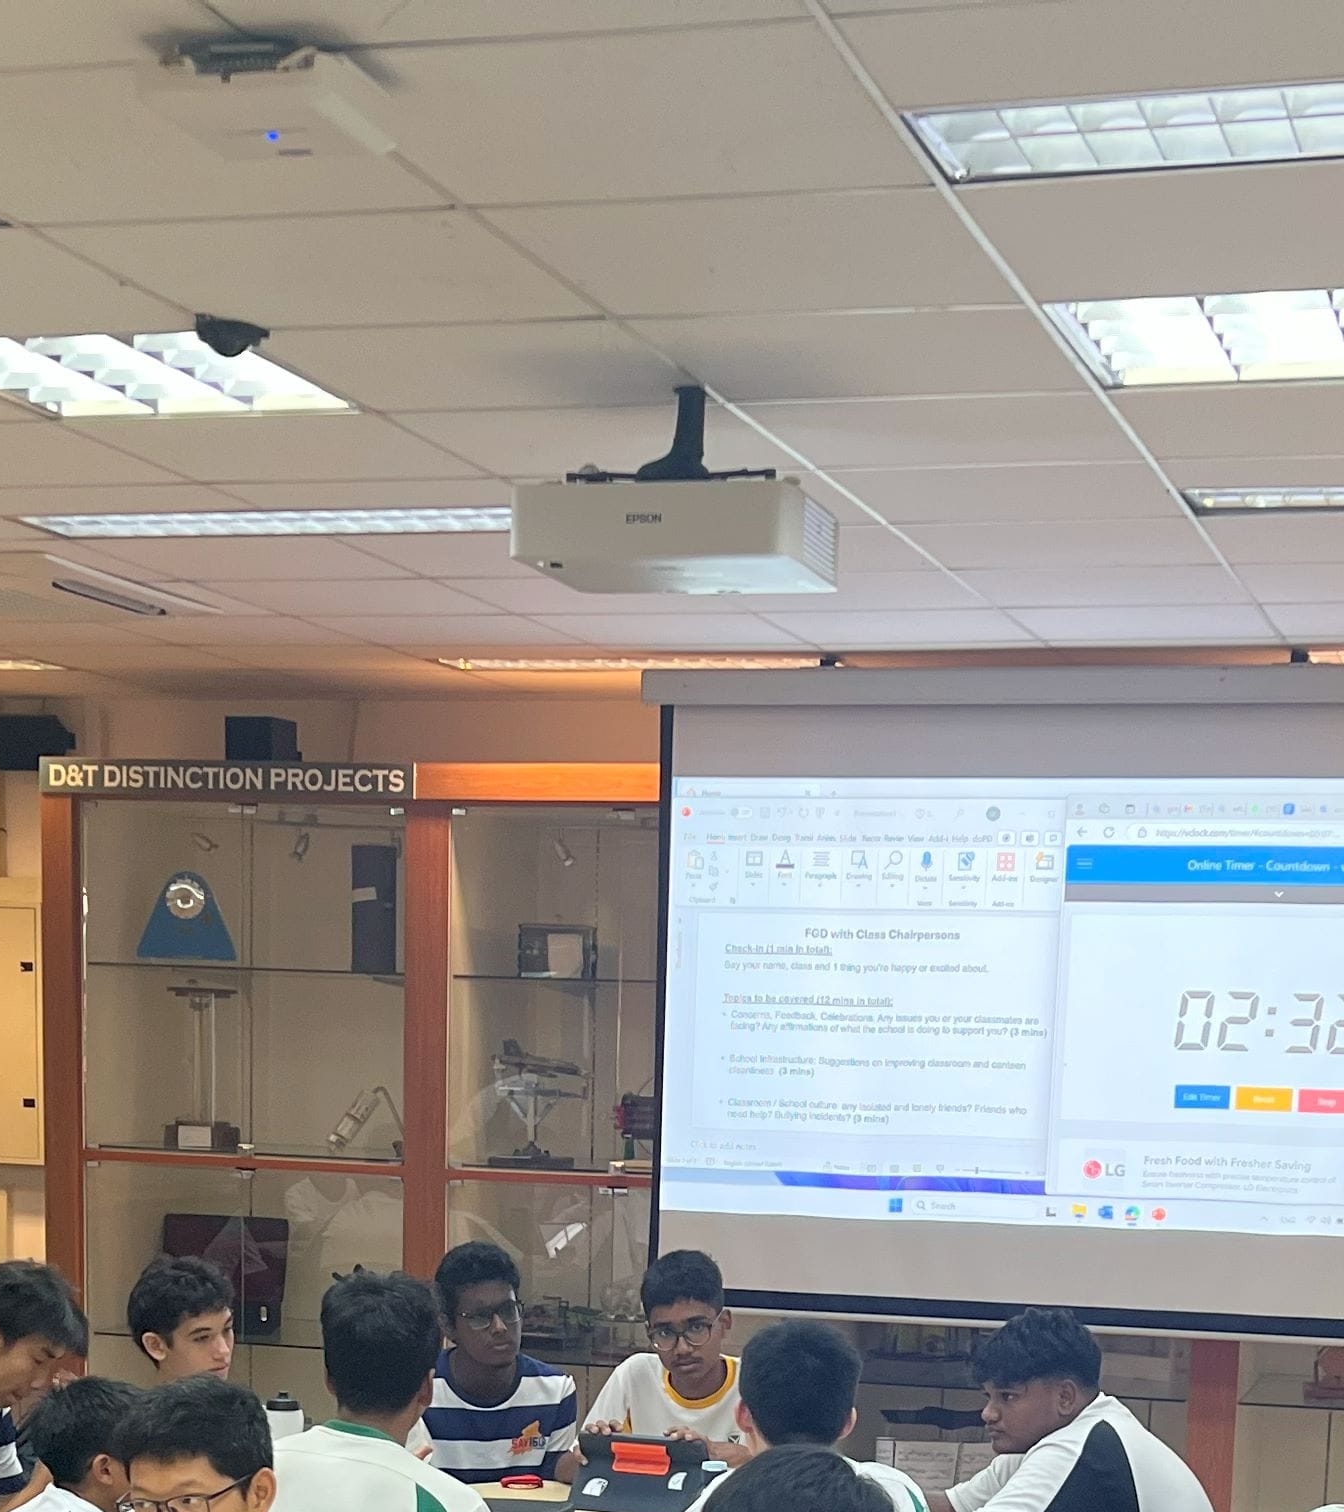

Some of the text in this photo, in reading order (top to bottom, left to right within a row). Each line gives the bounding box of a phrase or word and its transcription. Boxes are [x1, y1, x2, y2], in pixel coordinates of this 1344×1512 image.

[625, 512, 662, 525] EPSON
[48, 763, 406, 792] D&T DISTINCTION PROJECTS
[1187, 859, 1222, 871] Online
[1225, 859, 1255, 871] Timer
[1266, 860, 1331, 872] Countdown
[805, 928, 960, 942] FGD with Class Chairpersons
[742, 962, 760, 971] your
[763, 962, 788, 971] name,
[791, 962, 812, 970] class
[814, 962, 830, 971] and
[840, 963, 861, 973] thing
[863, 963, 889, 973] you're
[891, 963, 917, 974] happy
[930, 964, 960, 972] excited
[754, 994, 763, 1003] to
[766, 995, 777, 1003] be
[779, 996, 814, 1005] covered
[832, 996, 854, 1006] mins
[857, 996, 865, 1006] in
[731, 1011, 772, 1020] Concerns,
[877, 1013, 893, 1023] Any
[896, 1014, 922, 1022] issues
[924, 1015, 940, 1024] you
[953, 1015, 972, 1024] your
[974, 1015, 1022, 1025] classmates
[1025, 1017, 1039, 1025] are
[730, 1022, 760, 1032] facing?
[762, 1022, 777, 1033] Any
[780, 1023, 828, 1033] affirmations
[830, 1023, 839, 1033] of
[840, 1024, 860, 1033] what
[863, 1024, 876, 1033] the
[877, 1025, 905, 1034] school
[916, 1026, 940, 1036] doing
[942, 1026, 951, 1034] to
[952, 1027, 985, 1037] support
[987, 1027, 1008, 1037] you?
[1010, 1027, 1019, 1038] (3
[1021, 1027, 1048, 1038] mins)
[729, 1054, 757, 1064] School
[819, 1056, 870, 1068] Suggestions
[872, 1059, 883, 1067] on
[885, 1058, 925, 1069] improving
[927, 1059, 971, 1068] classroom
[973, 1059, 989, 1068] and
[991, 1061, 1026, 1070] canteen
[729, 1067, 815, 1078] cleanliness (3 mins)
[727, 1098, 771, 1107] Classroom
[779, 1099, 806, 1108] School
[841, 1102, 857, 1113] any
[859, 1101, 891, 1111] isolated
[894, 1103, 909, 1112] and
[911, 1103, 936, 1114] lonely
[938, 1103, 972, 1113] friends?
[974, 1104, 1006, 1114] Friends
[1009, 1106, 1027, 1115] who
[727, 1110, 889, 1125] need help? Bullying incidents? (3 mins)
[1105, 1164, 1126, 1177] LG
[1143, 1156, 1312, 1173] Fresh Food with Fresher Saving
